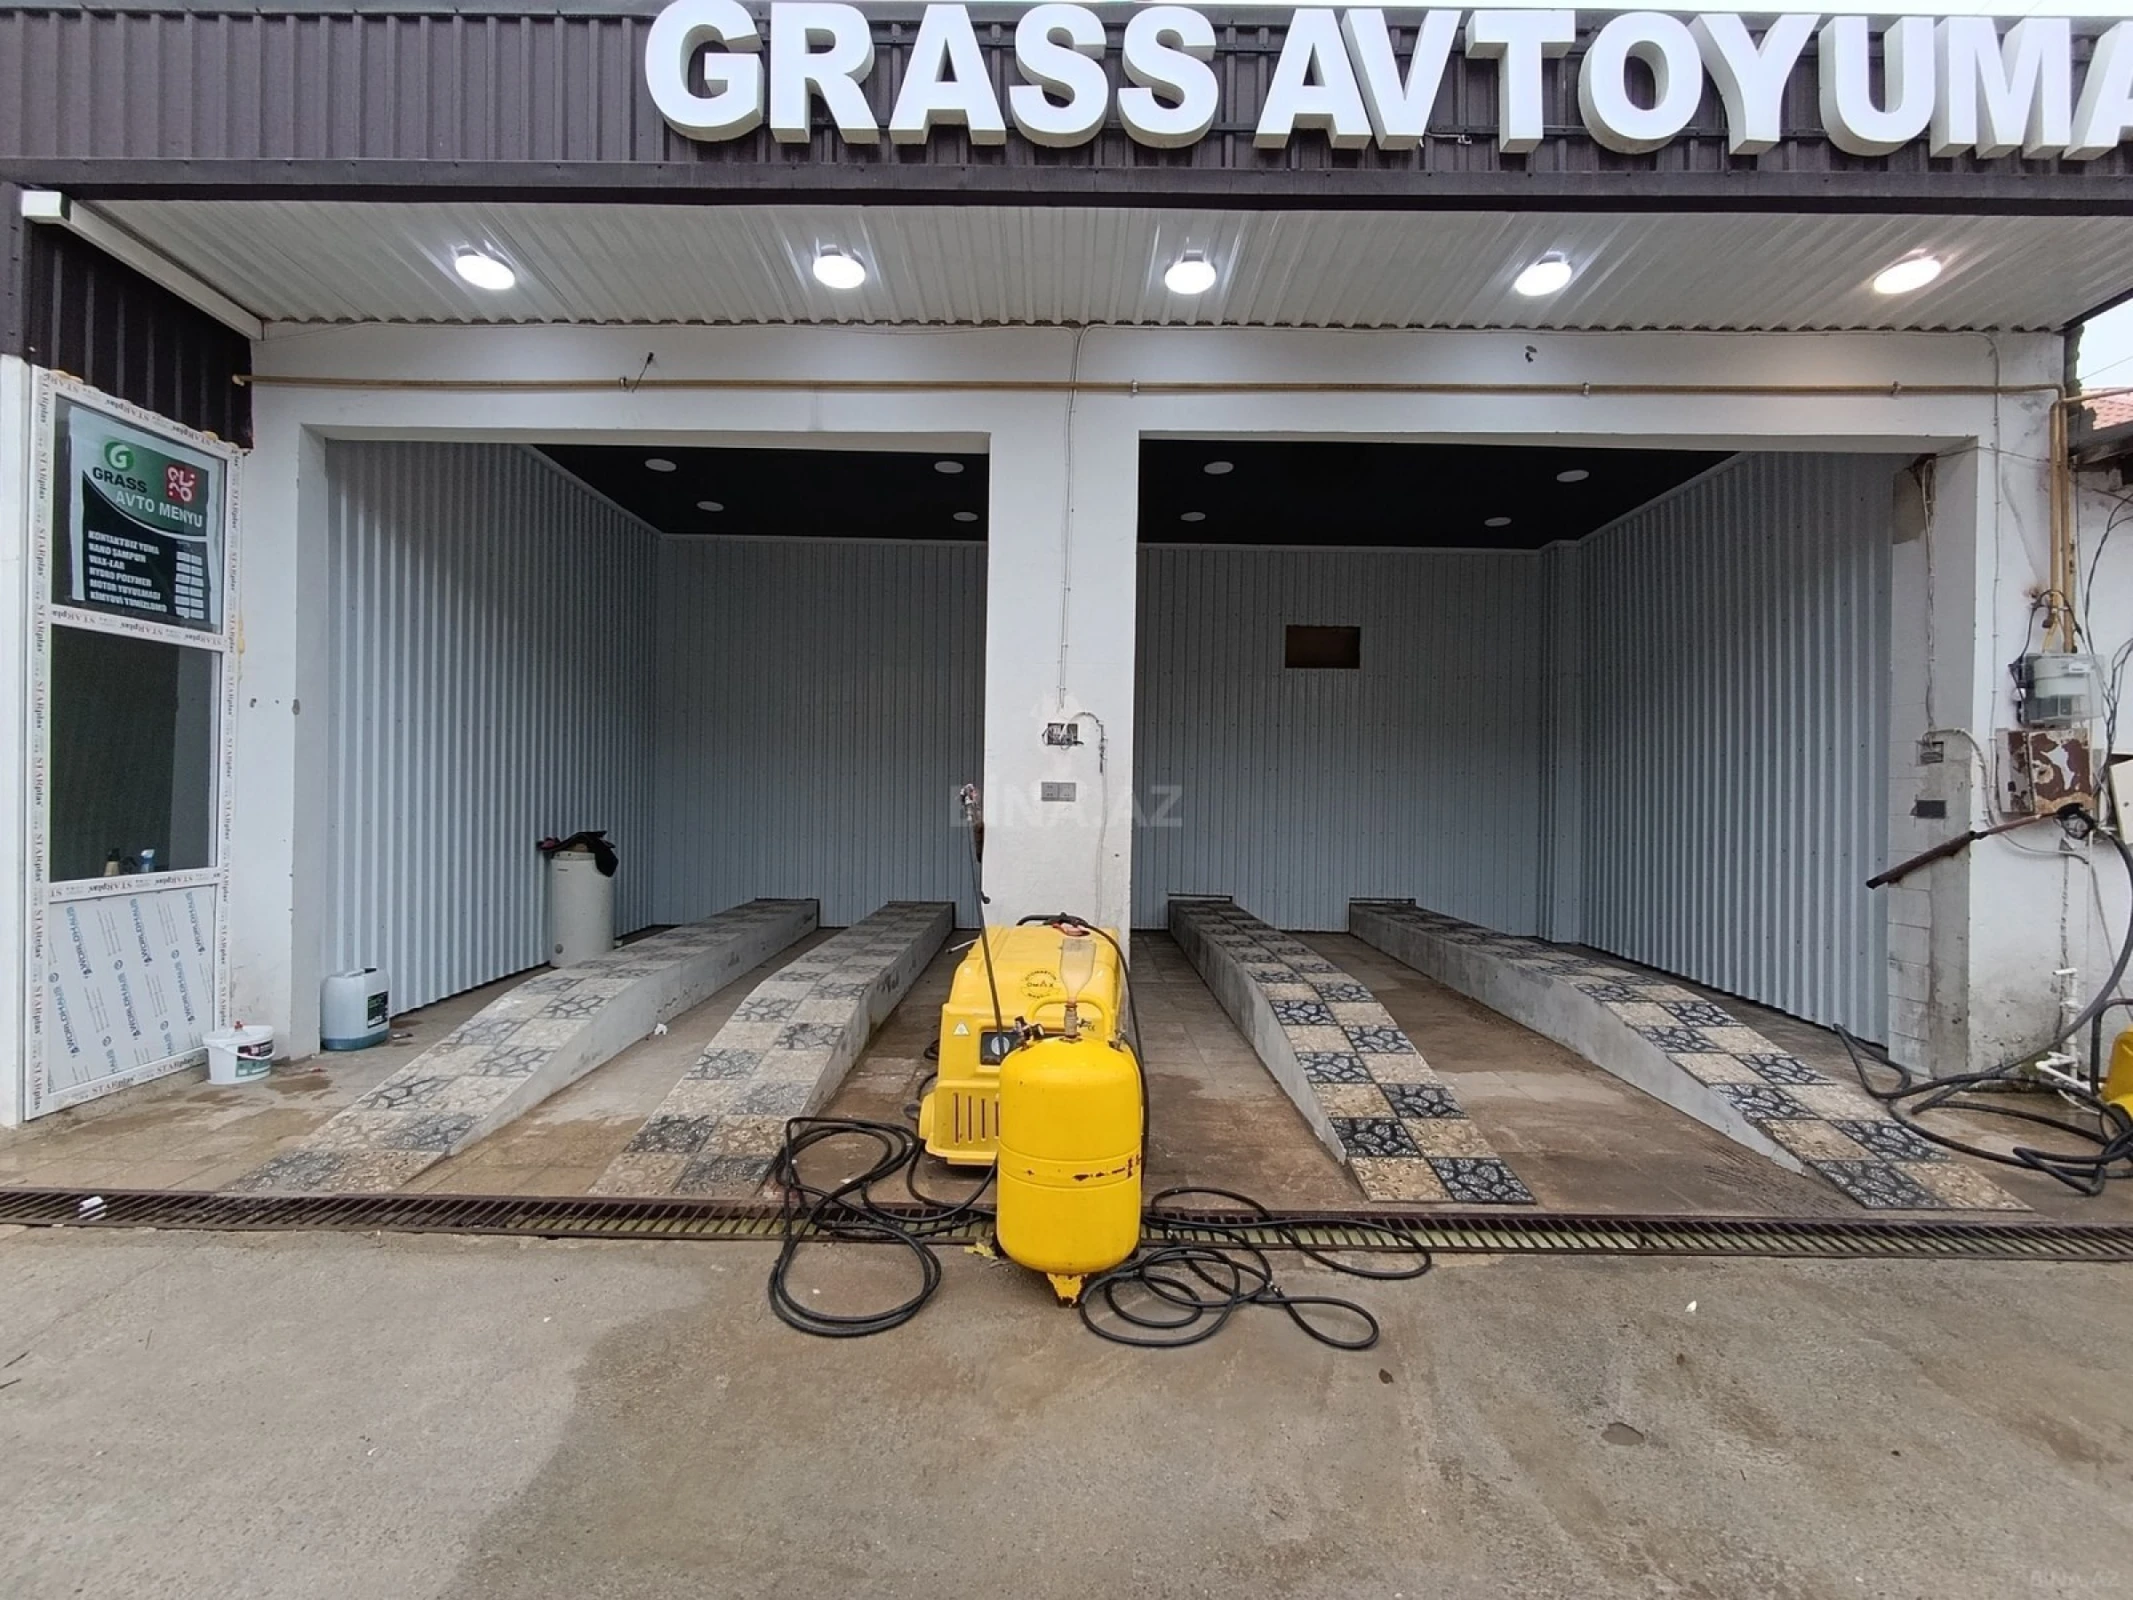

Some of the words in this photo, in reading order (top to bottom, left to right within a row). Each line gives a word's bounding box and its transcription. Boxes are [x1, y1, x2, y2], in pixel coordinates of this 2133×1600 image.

[645, 0, 1219, 148] GRASS
[92, 466, 148, 493] GRASS
[115, 490, 155, 512] AVTO
[159, 502, 203, 528] MENYU
